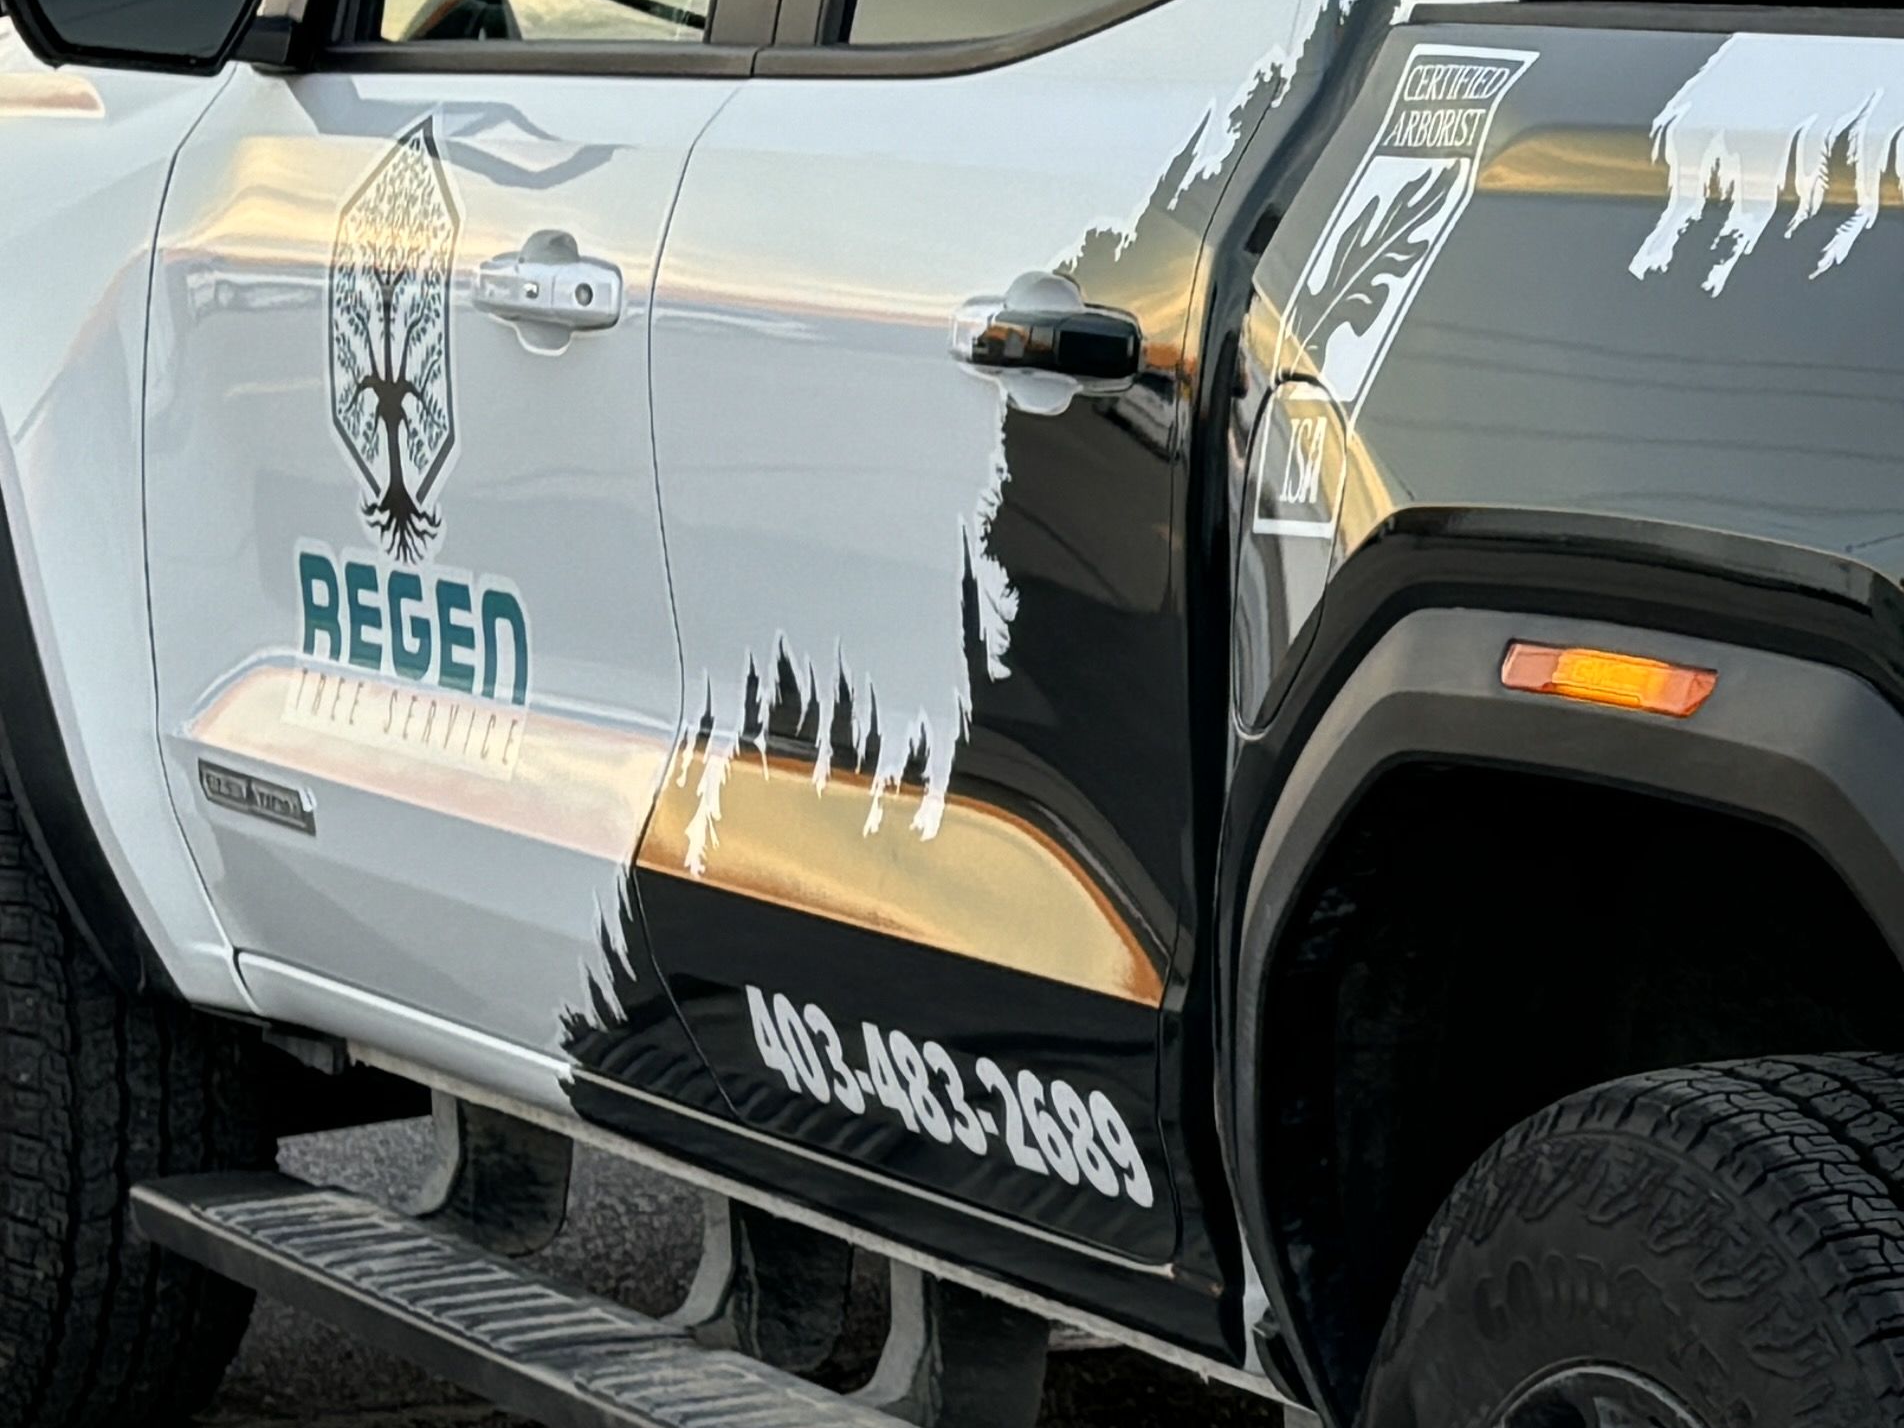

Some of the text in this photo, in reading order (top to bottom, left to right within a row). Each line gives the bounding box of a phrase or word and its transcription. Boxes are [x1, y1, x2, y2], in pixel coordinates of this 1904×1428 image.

[1383, 108, 1487, 148] ARBORIST
[1404, 64, 1511, 102] CERTIFIED
[1279, 417, 1327, 504] ISA
[299, 552, 530, 705] REGEN
[296, 668, 519, 765] TREE SERVICE
[745, 984, 1154, 1208] 403-483-2689
